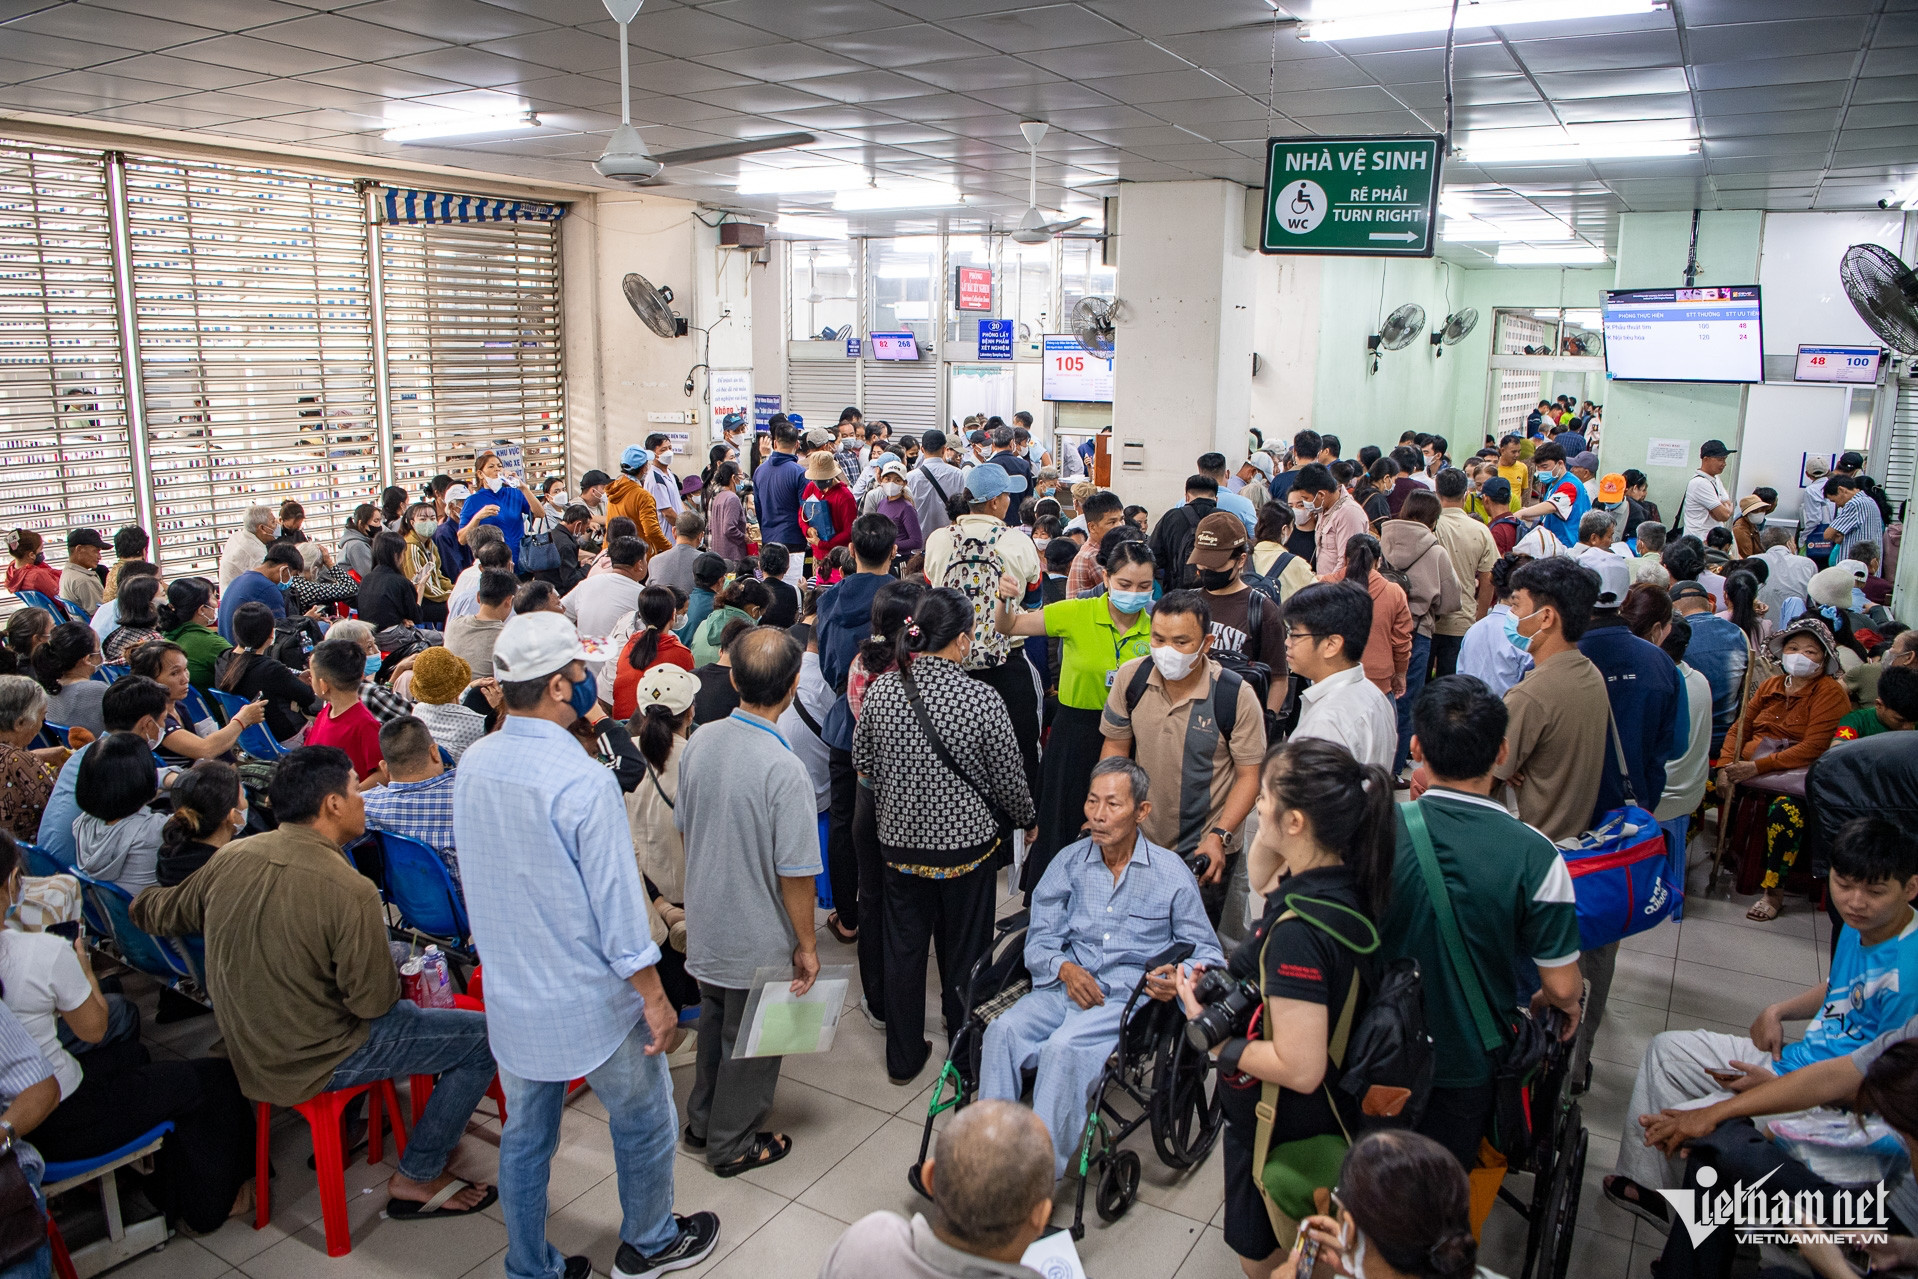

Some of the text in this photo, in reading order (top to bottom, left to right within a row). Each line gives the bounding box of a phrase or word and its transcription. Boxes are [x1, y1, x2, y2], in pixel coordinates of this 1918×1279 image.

[1285, 148, 1427, 176] NHÀ VỆ SINH
[1350, 185, 1408, 201] RẼ PHẢI
[1333, 209, 1422, 222] TURN RIGHT
[1288, 219, 1308, 230] WC
[1056, 357, 1084, 371] 105
[1810, 357, 1826, 365] 48
[1846, 358, 1869, 366] 100
[509, 447, 519, 456] VỰC
[502, 460, 512, 468] ỪNG
